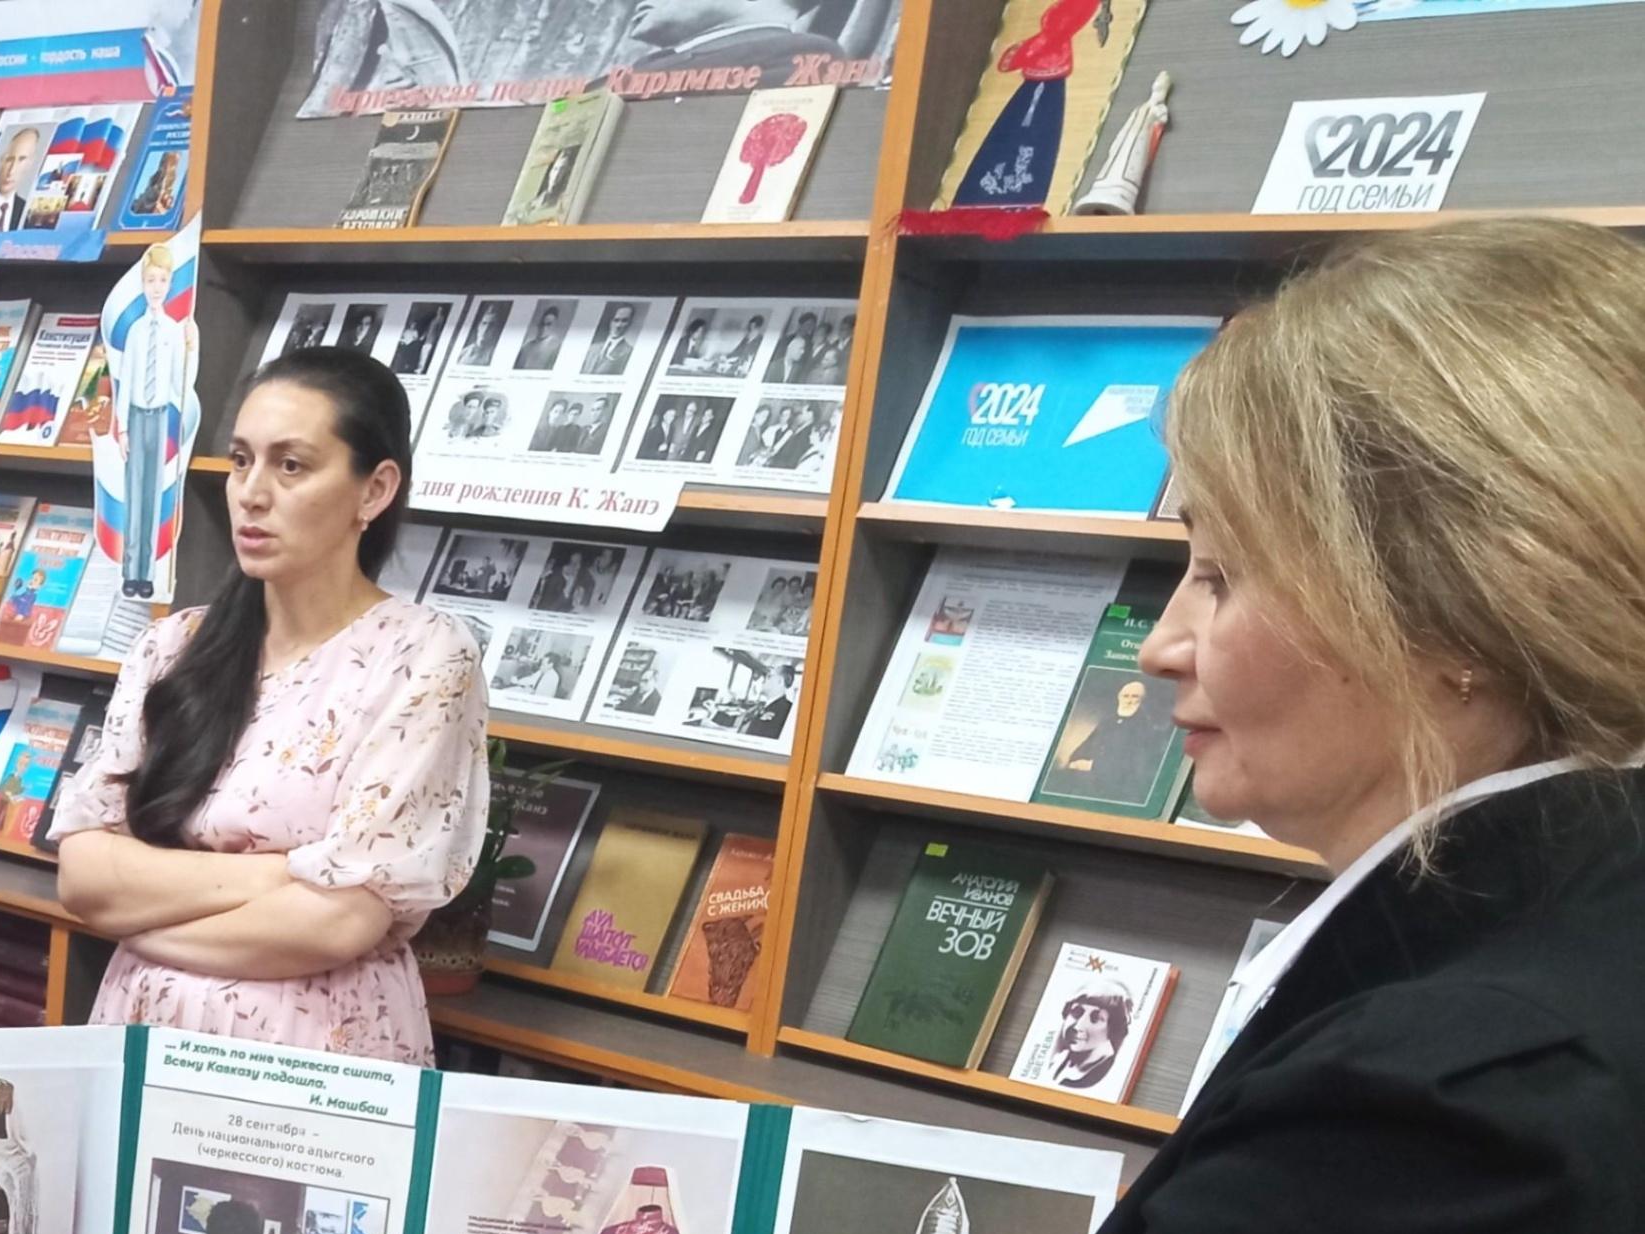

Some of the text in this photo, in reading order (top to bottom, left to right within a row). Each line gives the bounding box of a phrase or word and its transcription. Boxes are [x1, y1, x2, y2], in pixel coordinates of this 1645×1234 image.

[1314, 110, 1463, 178] 2024
[971, 382, 1047, 426] 2024
[417, 480, 660, 516] дня рождения К. Жанэ
[707, 905, 717, 917] С
[708, 885, 765, 905] СВАДЬБА
[964, 888, 1014, 906] ИВАНОВ
[584, 909, 614, 927] АУЛ
[926, 900, 1007, 933] ВЕЧНЫЙ
[938, 926, 996, 960] ЗОВ
[164, 1055, 327, 1090] Всему Кавказу подошла.
[180, 1040, 191, 1051] И
[192, 1043, 227, 1057] хоть
[230, 1049, 246, 1060] по
[249, 1053, 274, 1065] мне
[277, 1056, 339, 1075] черкеска
[343, 1067, 395, 1085] сшита,
[309, 1094, 388, 1116] И. Машбаш
[228, 1114, 242, 1127] 28
[246, 1119, 306, 1137] сентября
[172, 1122, 375, 1166] День национального адыгского
[198, 1143, 284, 1168] (черкесского)
